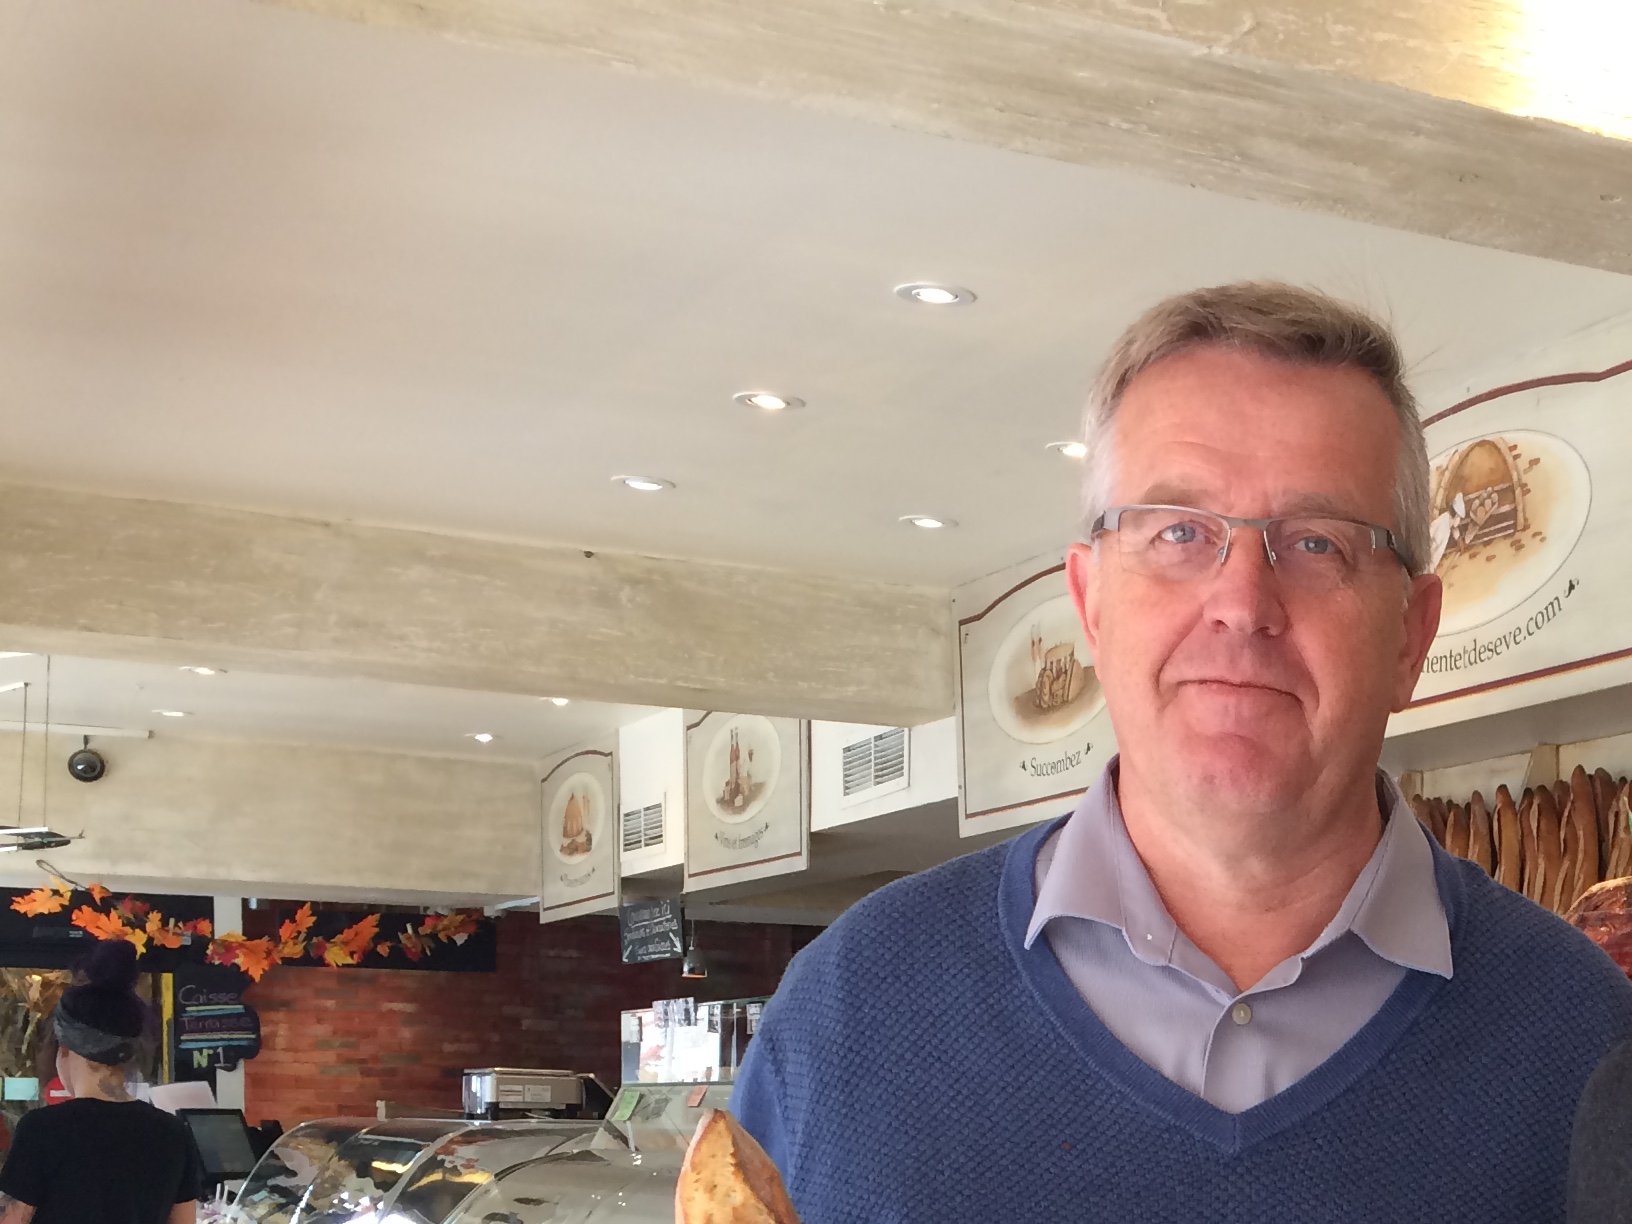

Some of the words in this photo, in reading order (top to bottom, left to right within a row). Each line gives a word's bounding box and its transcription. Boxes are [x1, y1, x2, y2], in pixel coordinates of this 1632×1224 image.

[1030, 750, 1083, 777] Succombez
[179, 984, 239, 1005] Caisse
[180, 1016, 255, 1031] Terrasse
